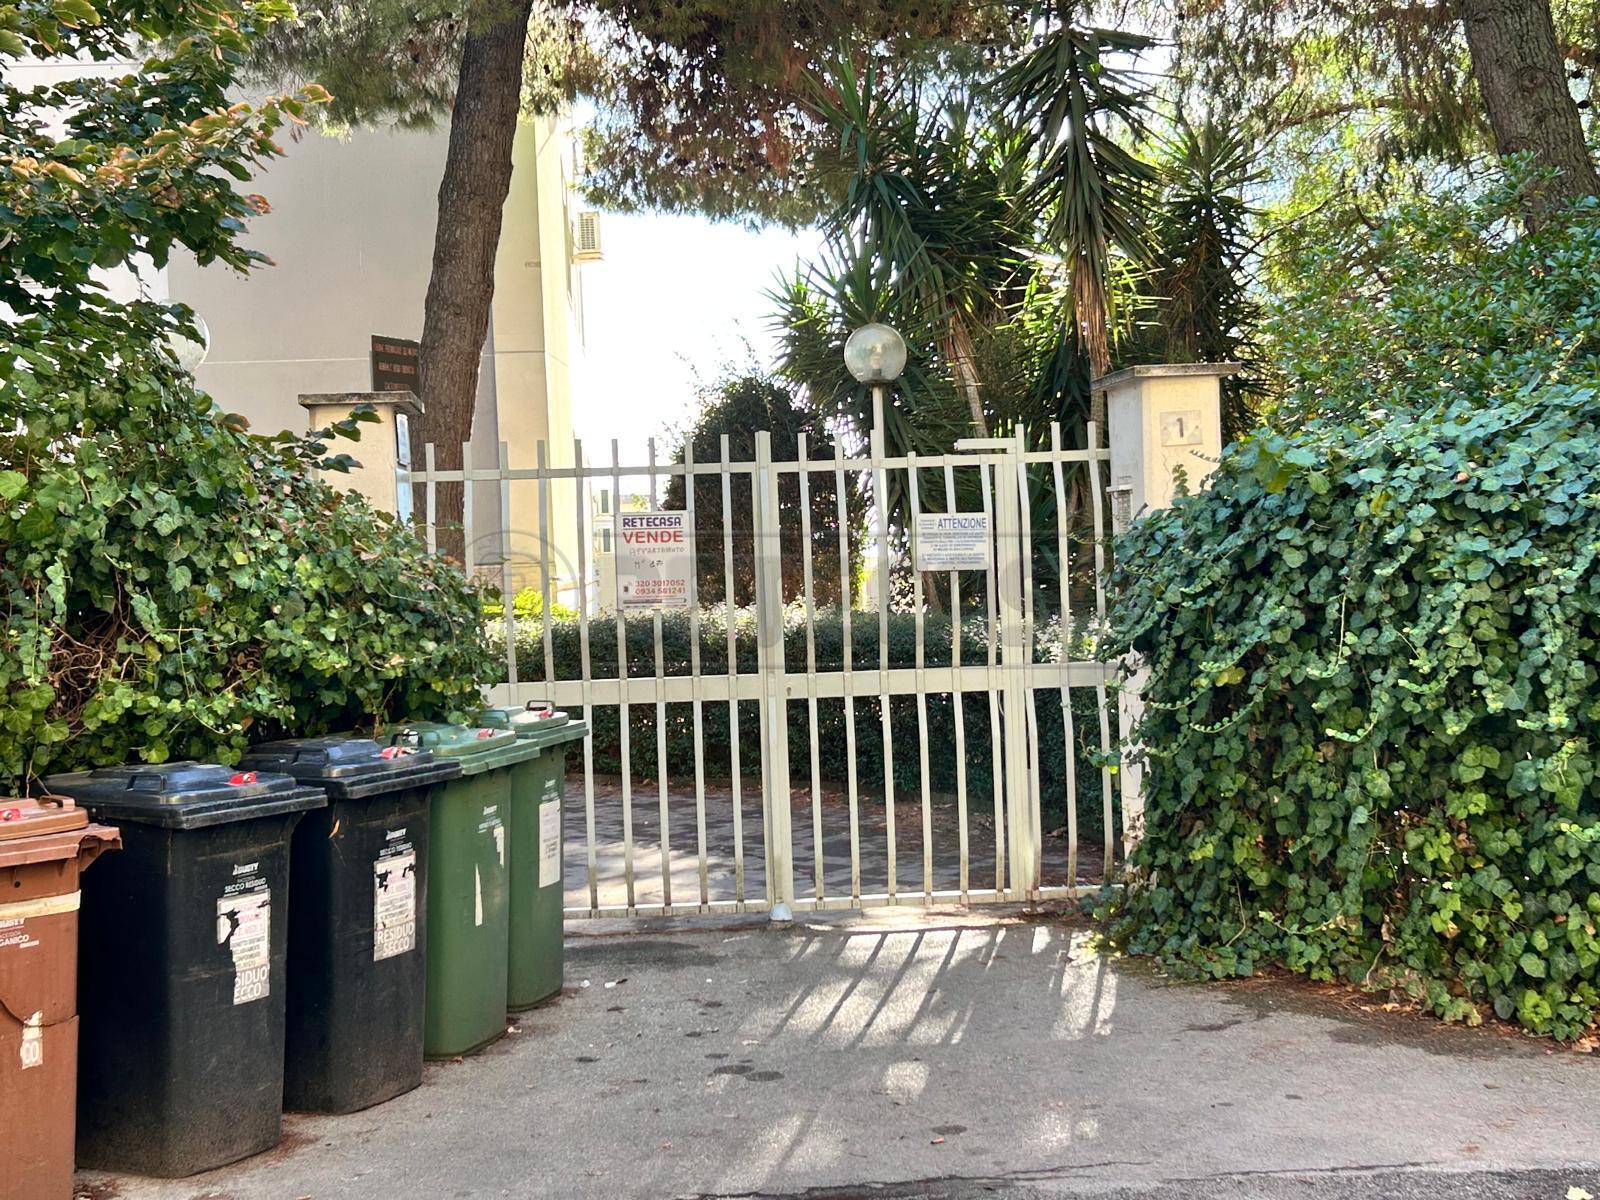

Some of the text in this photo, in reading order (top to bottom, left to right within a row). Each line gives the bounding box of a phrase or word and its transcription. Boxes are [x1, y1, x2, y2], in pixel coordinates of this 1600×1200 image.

[1176, 417, 1184, 438] 1
[622, 516, 682, 528] RETECASA
[937, 517, 987, 529] ATTENZIONE
[622, 530, 684, 544] VENDE
[635, 579, 650, 587] 320
[224, 882, 245, 893] SECCO
[377, 922, 414, 943] RESIDUO
[382, 936, 410, 956] SECCO
